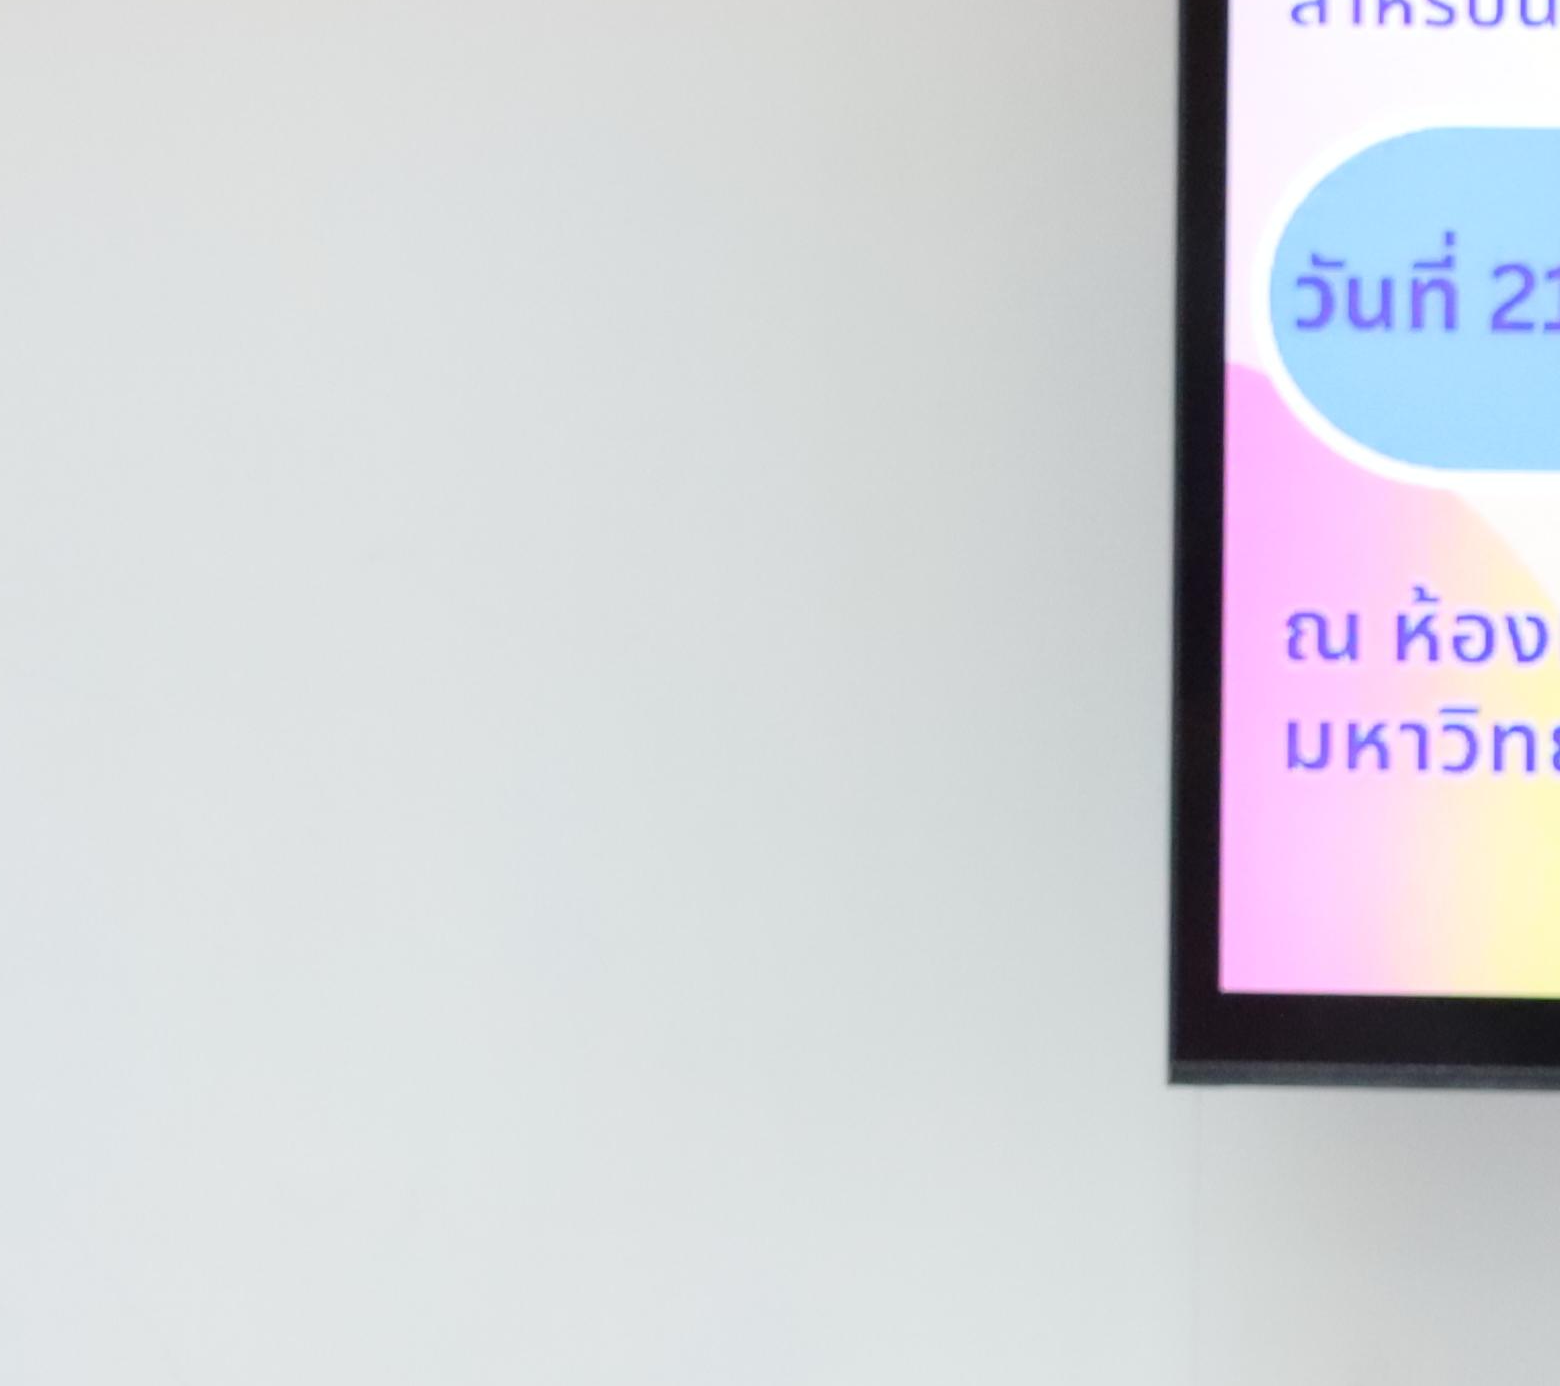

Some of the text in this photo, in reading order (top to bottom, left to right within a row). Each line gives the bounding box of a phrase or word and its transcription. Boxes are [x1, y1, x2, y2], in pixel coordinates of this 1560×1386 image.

[1293, 232, 1459, 334] วันที่
[1285, 611, 1360, 663] ณ
